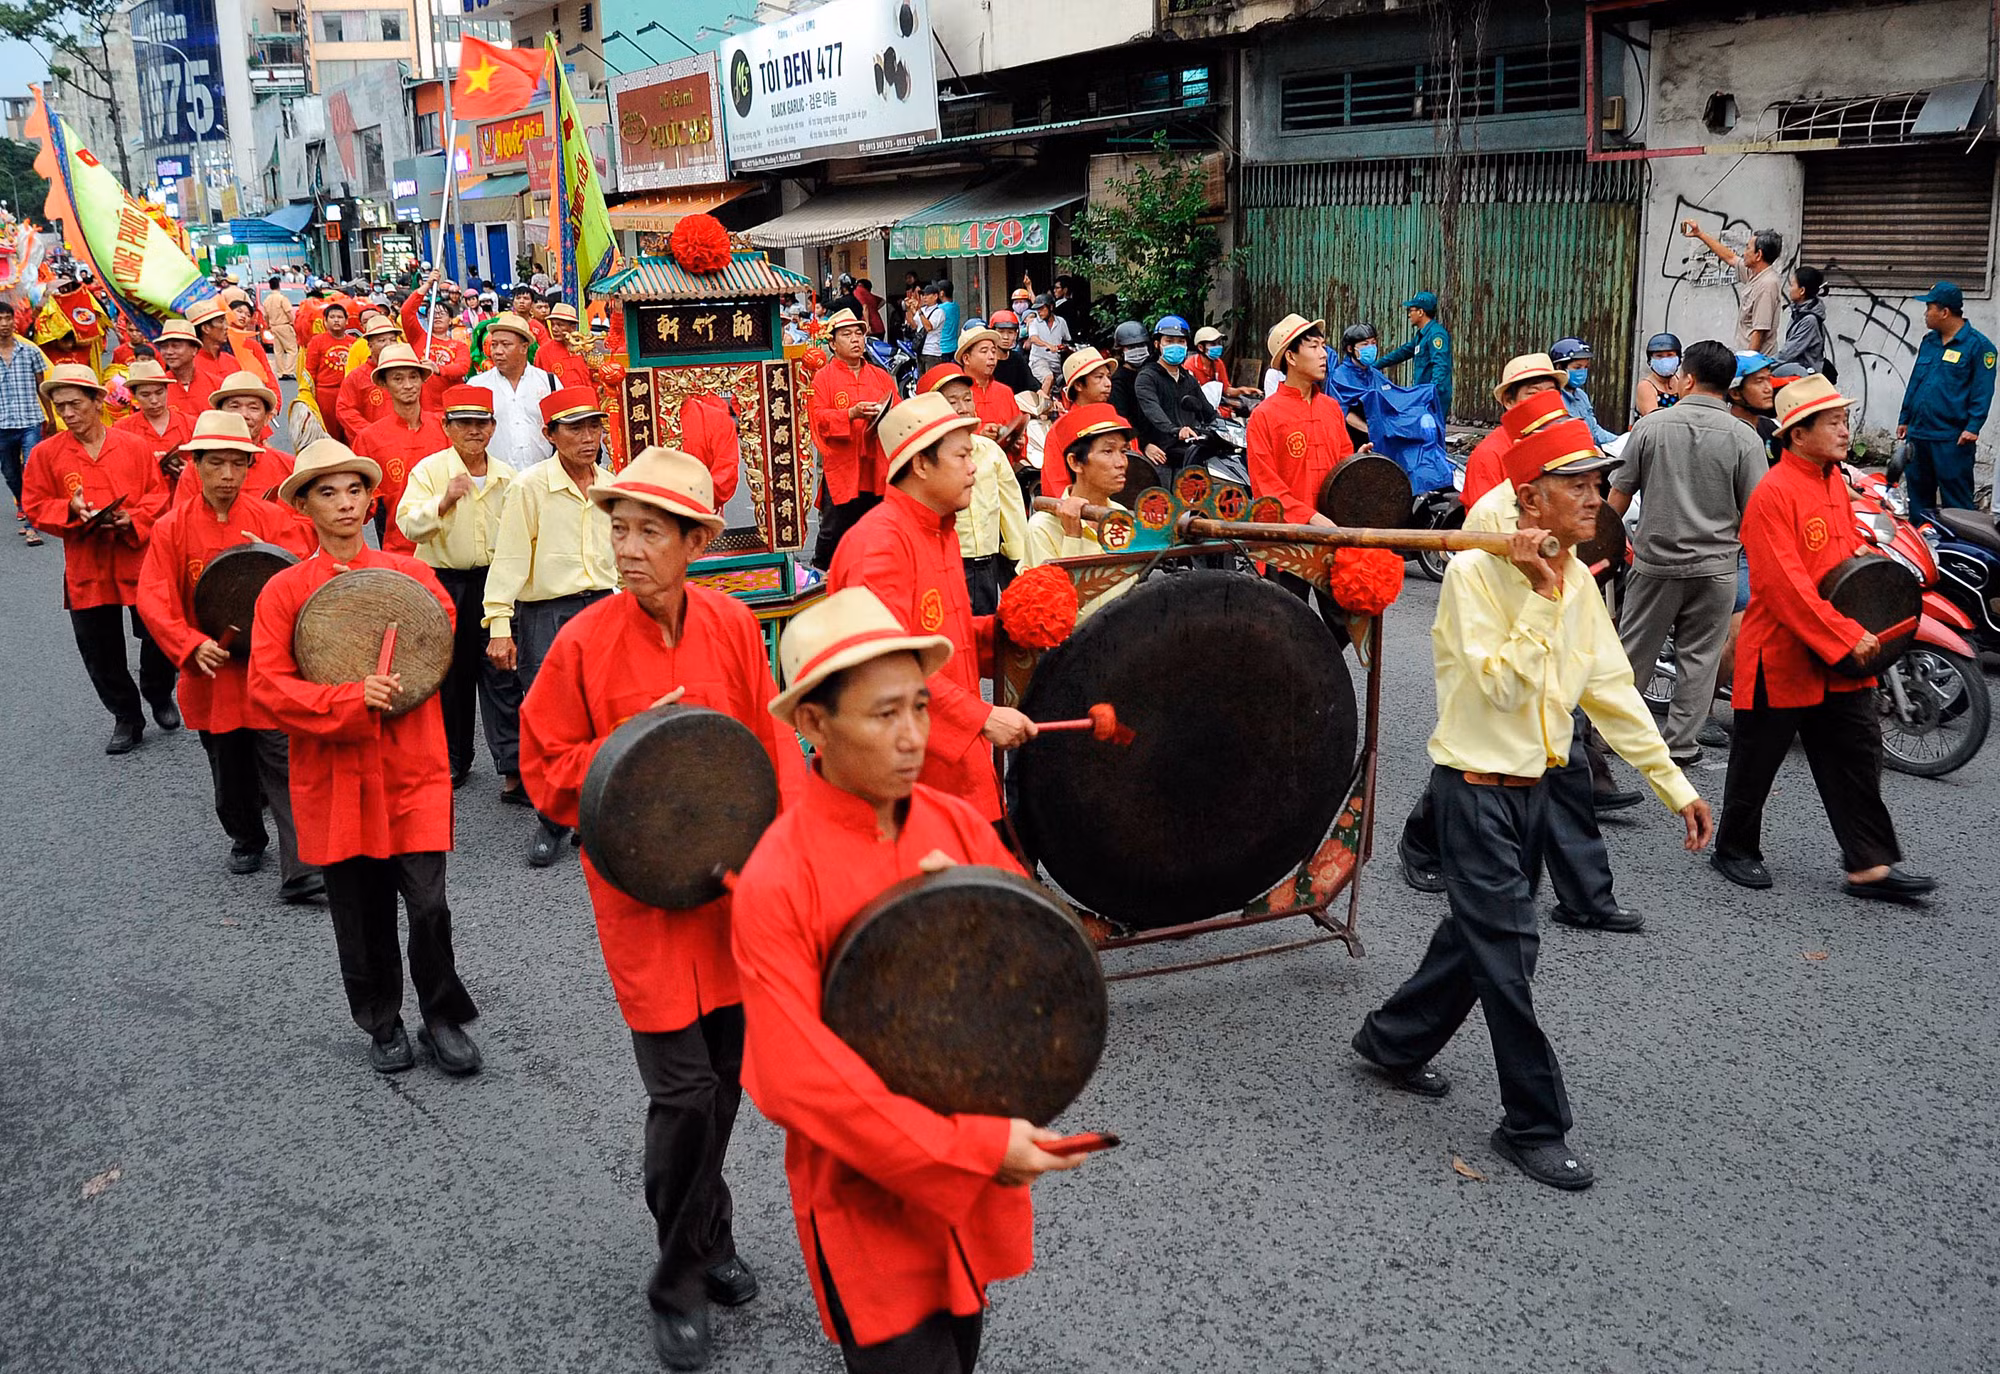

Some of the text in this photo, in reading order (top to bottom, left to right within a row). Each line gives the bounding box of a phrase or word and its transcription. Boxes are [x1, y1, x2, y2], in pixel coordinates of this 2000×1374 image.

[759, 41, 843, 95] TỎI ĐEN 477
[771, 102, 787, 119] BLACK
[787, 99, 805, 116] GARLIC
[962, 219, 1025, 250] 479
[112, 247, 144, 284] LONG
